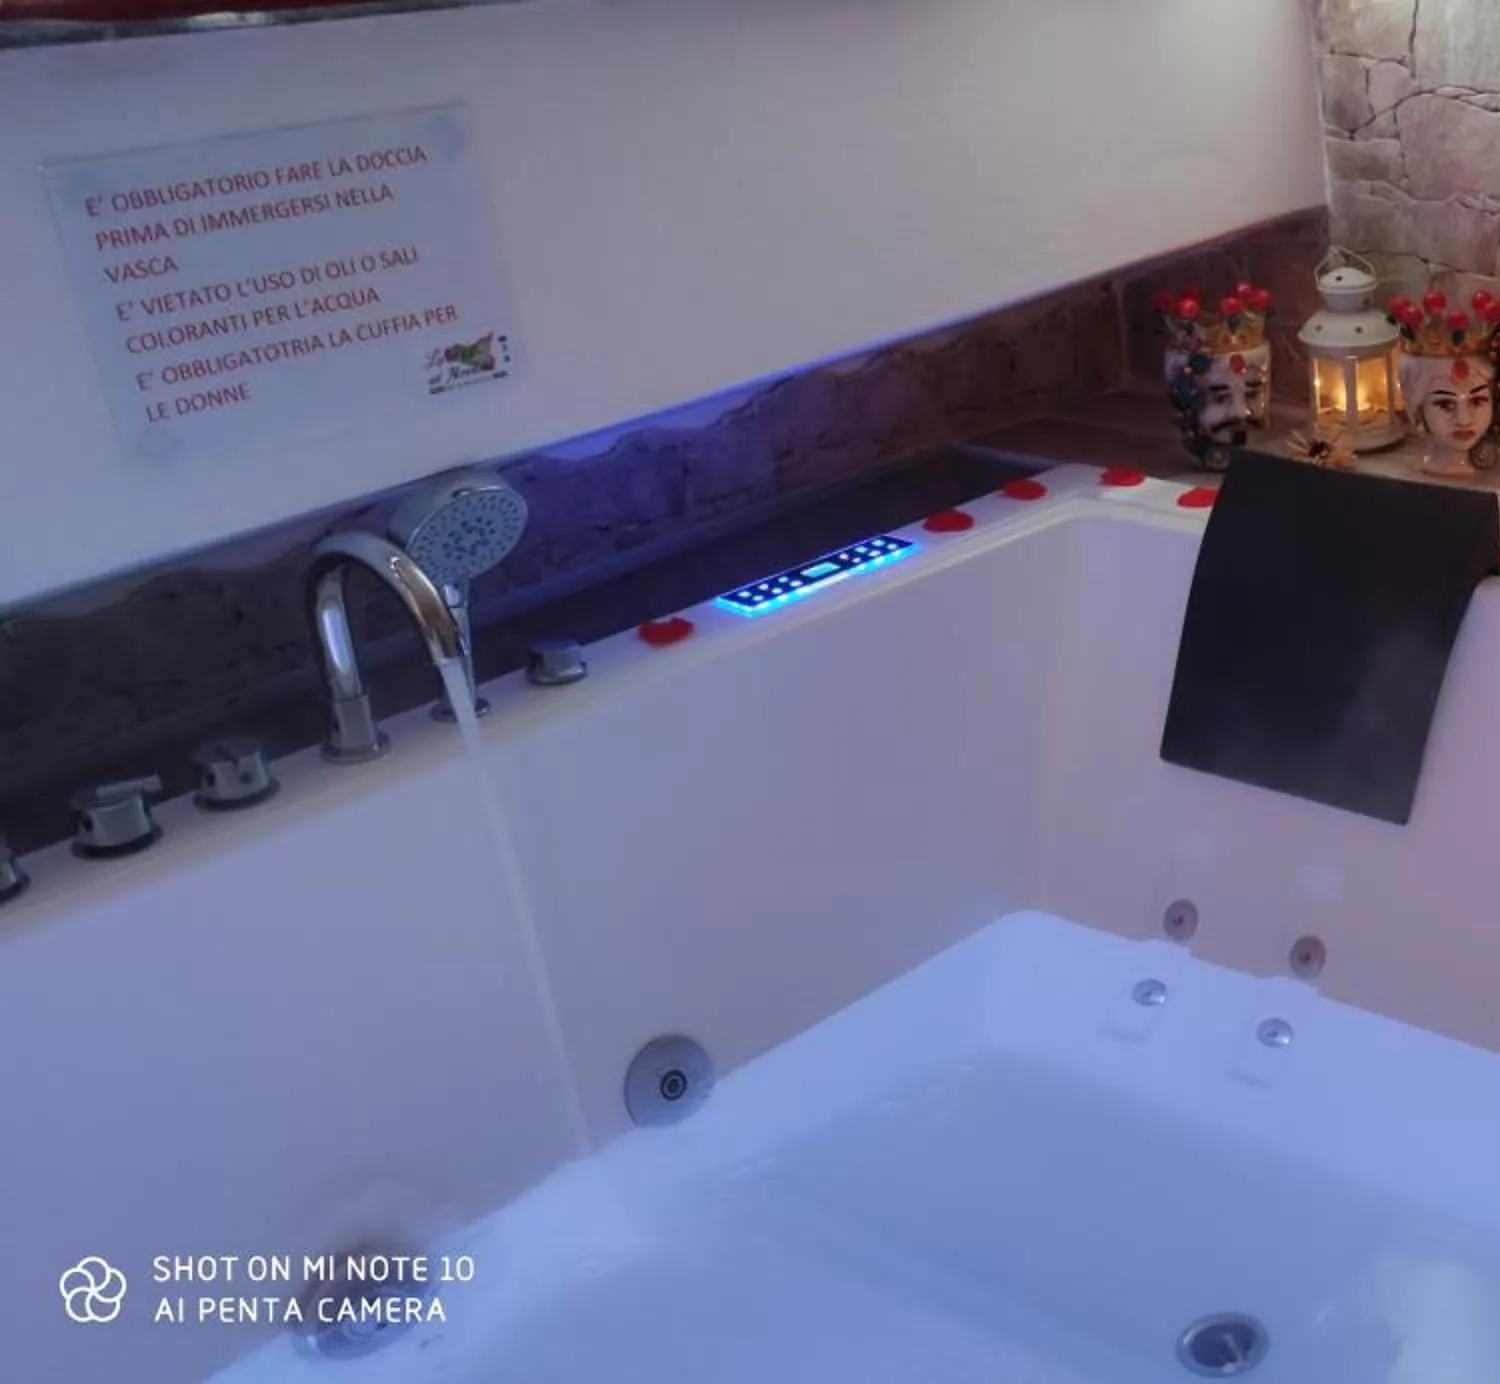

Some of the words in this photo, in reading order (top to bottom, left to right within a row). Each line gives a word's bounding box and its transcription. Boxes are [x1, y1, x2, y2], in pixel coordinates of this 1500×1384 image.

[85, 195, 103, 218] E'
[111, 169, 271, 213] OBBLIGATORIO
[275, 161, 323, 185] FARE
[328, 156, 353, 178] LA
[355, 145, 428, 173] DOCCIA
[95, 222, 170, 251] PRIMA
[173, 216, 196, 238] DI
[201, 192, 331, 232] IMMERGERSI
[335, 183, 394, 209] NELLA
[104, 256, 180, 284] VASCA
[115, 300, 134, 322] E'
[140, 283, 232, 315] VIETATO
[236, 271, 295, 298] L'USO
[300, 265, 321, 285] DI
[325, 257, 356, 279] OLI
[361, 255, 376, 273] O
[380, 245, 418, 269] SALI
[126, 314, 247, 354] COLORANTI
[252, 304, 291, 328] PER
[294, 287, 381, 318] L'ACQUA
[135, 371, 153, 391] E'
[161, 334, 325, 385] OBBLIGATOTRIA
[328, 327, 353, 348] LA
[356, 313, 421, 341] CUFFIA
[424, 304, 458, 326] PER
[146, 401, 171, 423] LE
[175, 382, 252, 415] DONNE
